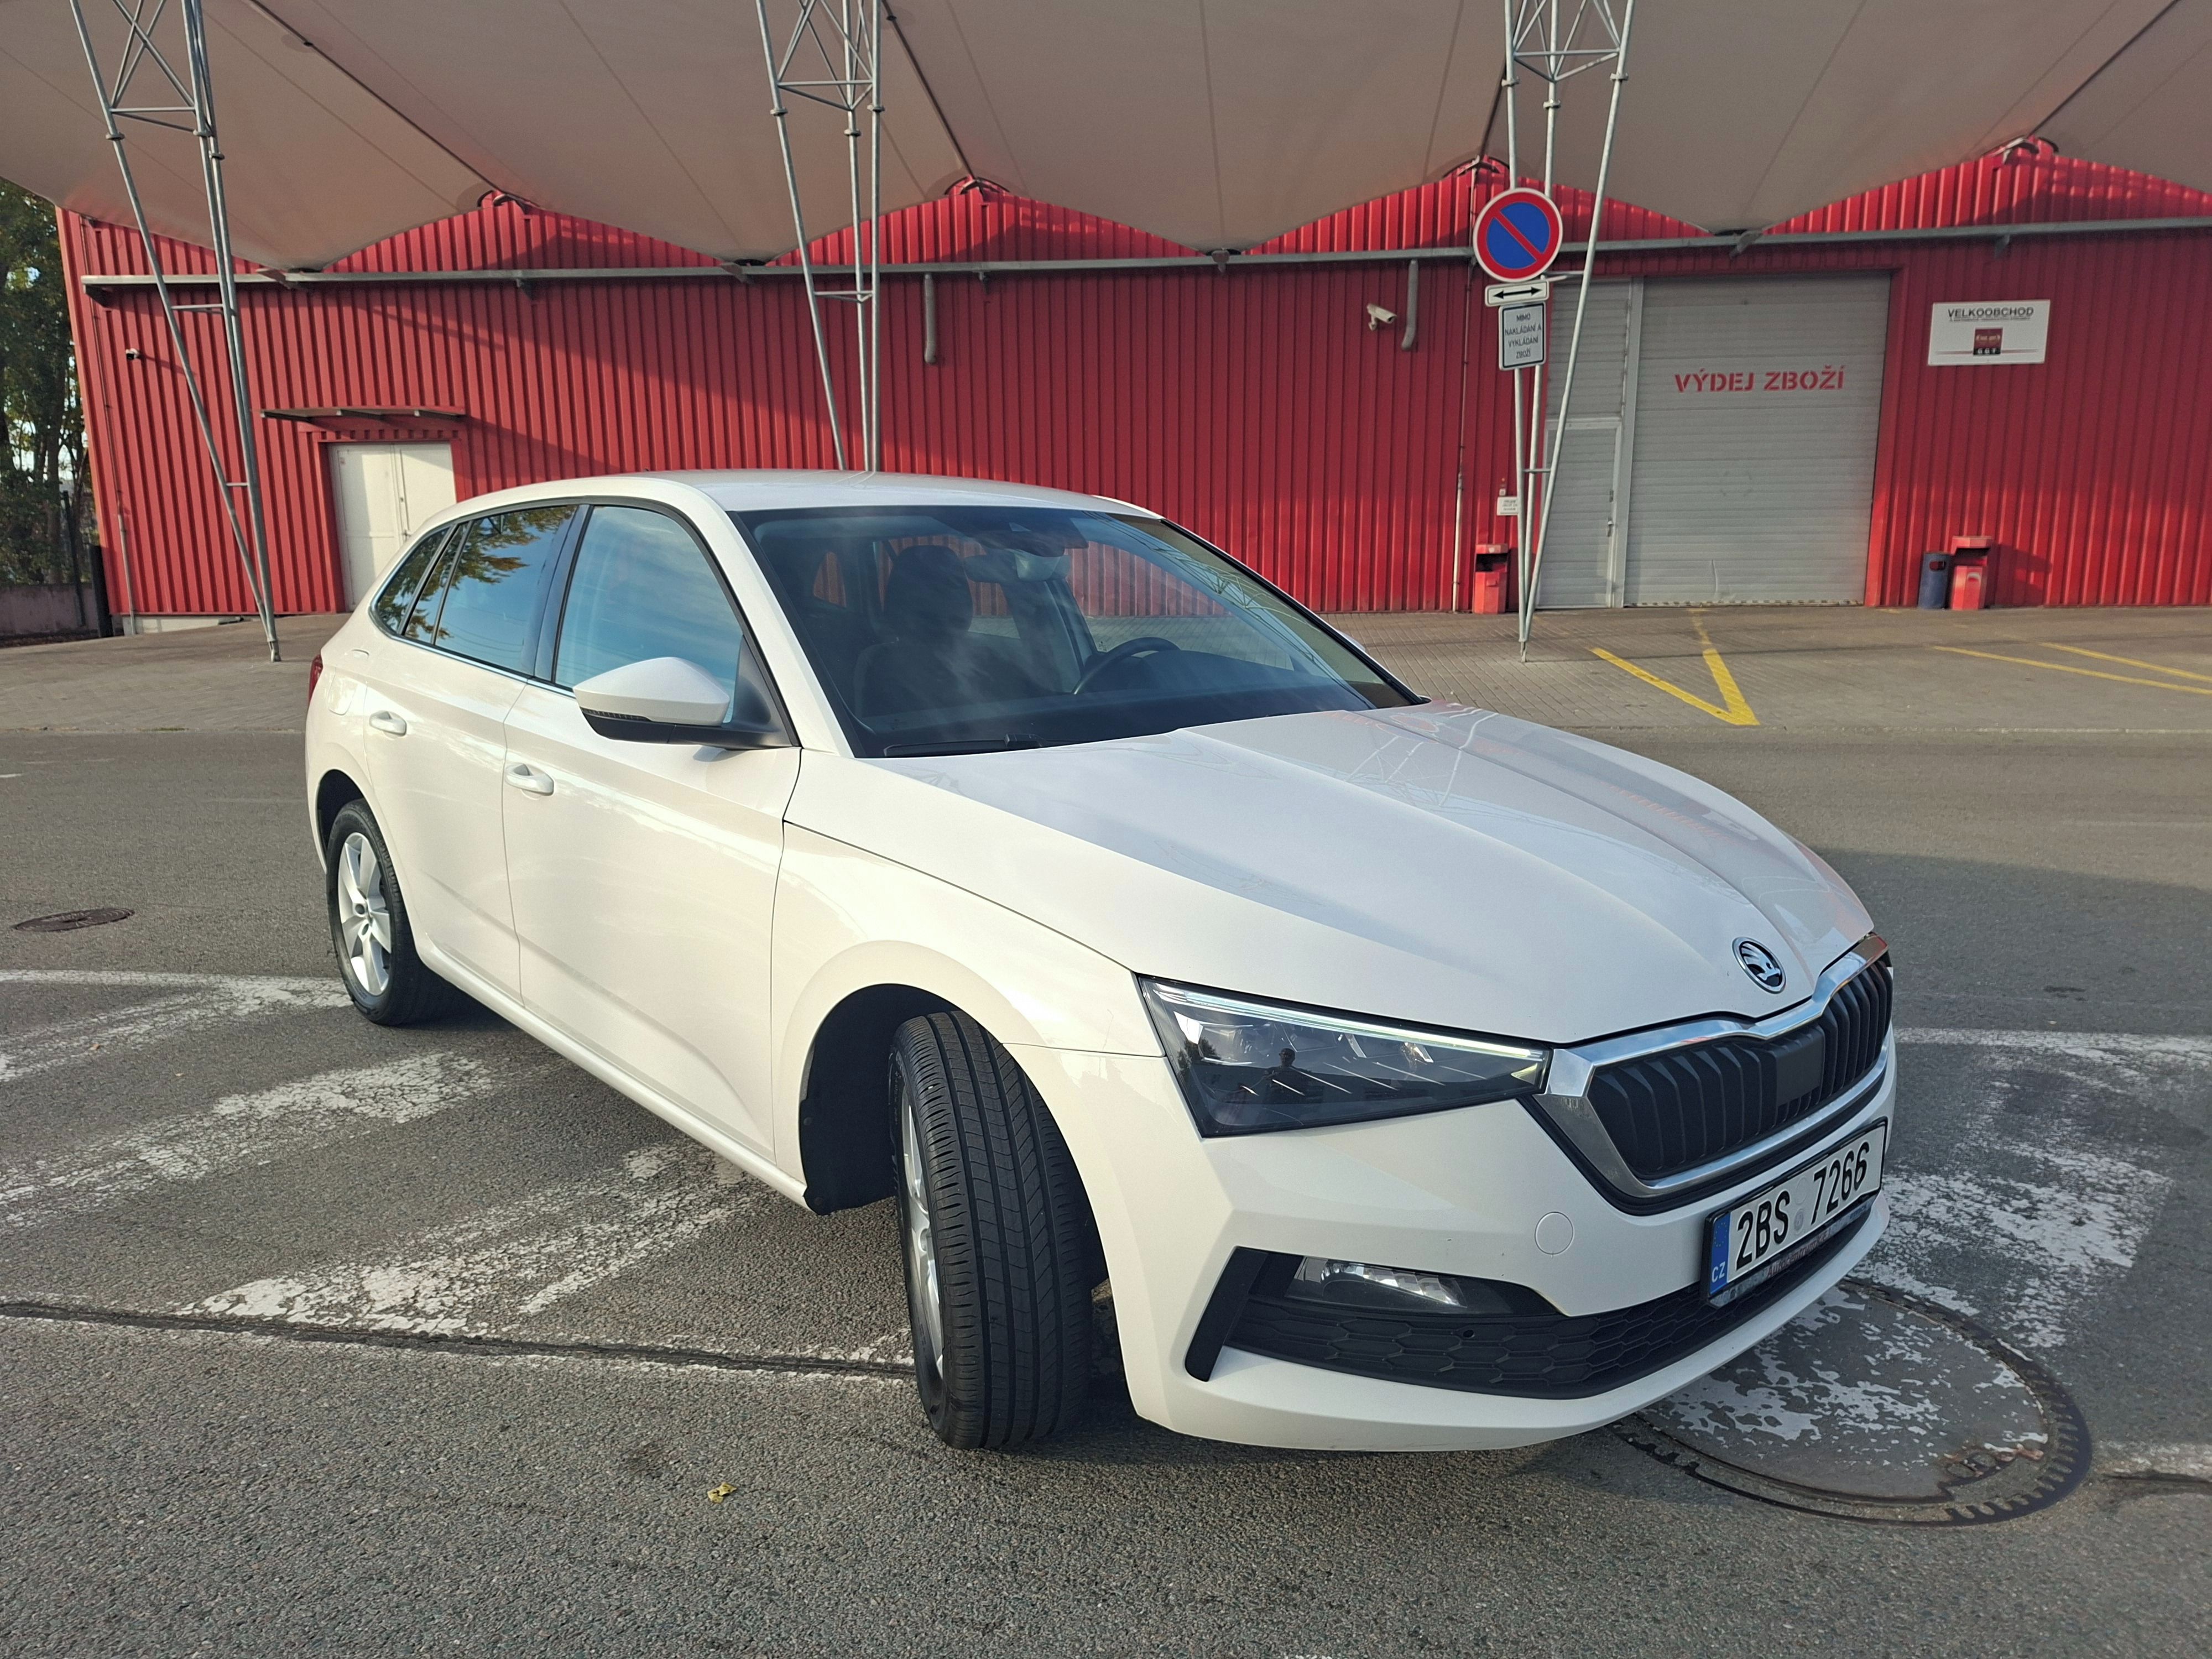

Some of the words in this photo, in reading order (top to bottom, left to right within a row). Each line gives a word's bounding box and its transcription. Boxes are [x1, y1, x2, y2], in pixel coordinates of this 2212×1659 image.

[1948, 307, 2034, 318] VELKOOBCHOD
[1674, 368, 1755, 393] VÝDEJ
[1764, 364, 1845, 391] ZBOŽÍ
[1736, 1190, 1791, 1271] 2BS
[1811, 1141, 1870, 1225] 7266
[1712, 1261, 1725, 1282] CZ
